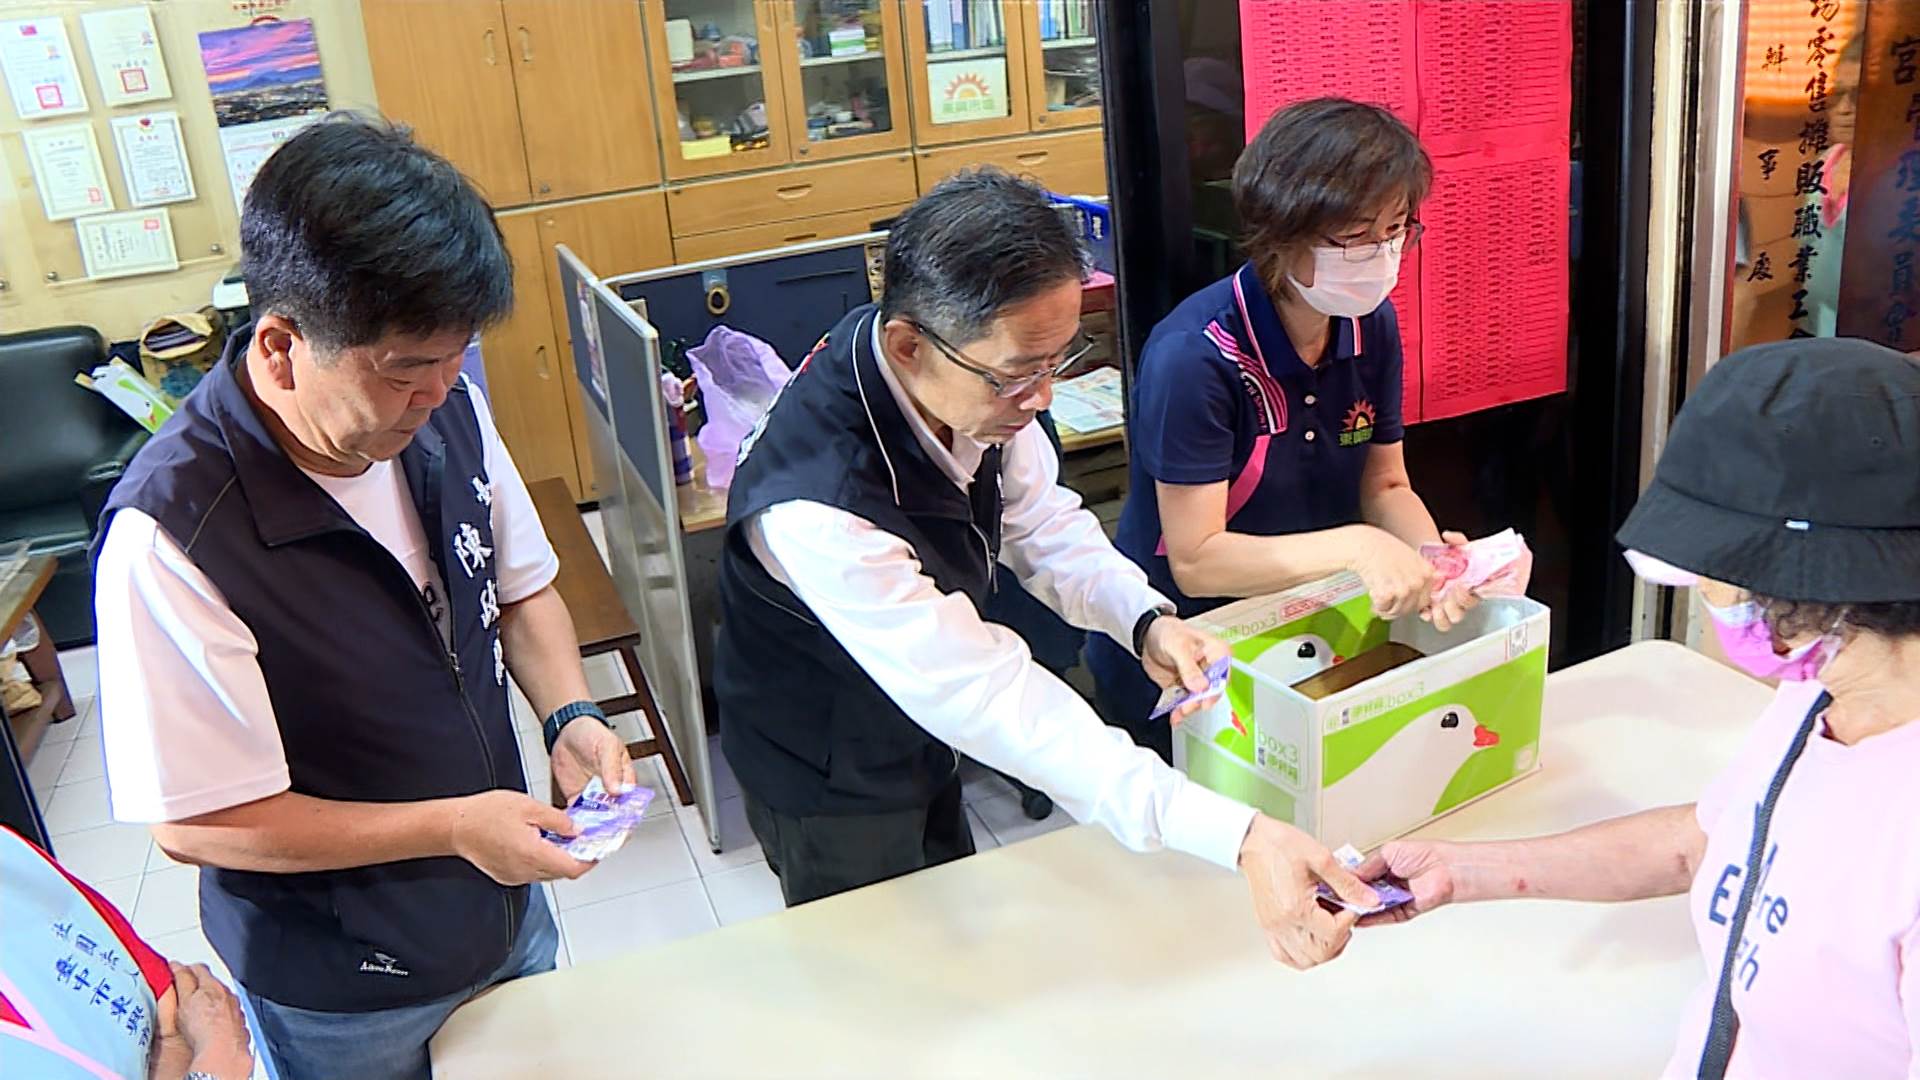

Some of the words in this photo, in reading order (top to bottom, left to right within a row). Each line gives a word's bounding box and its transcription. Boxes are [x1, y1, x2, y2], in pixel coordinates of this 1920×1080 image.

[1788, 0, 1841, 338] 場零售攤販職業工
